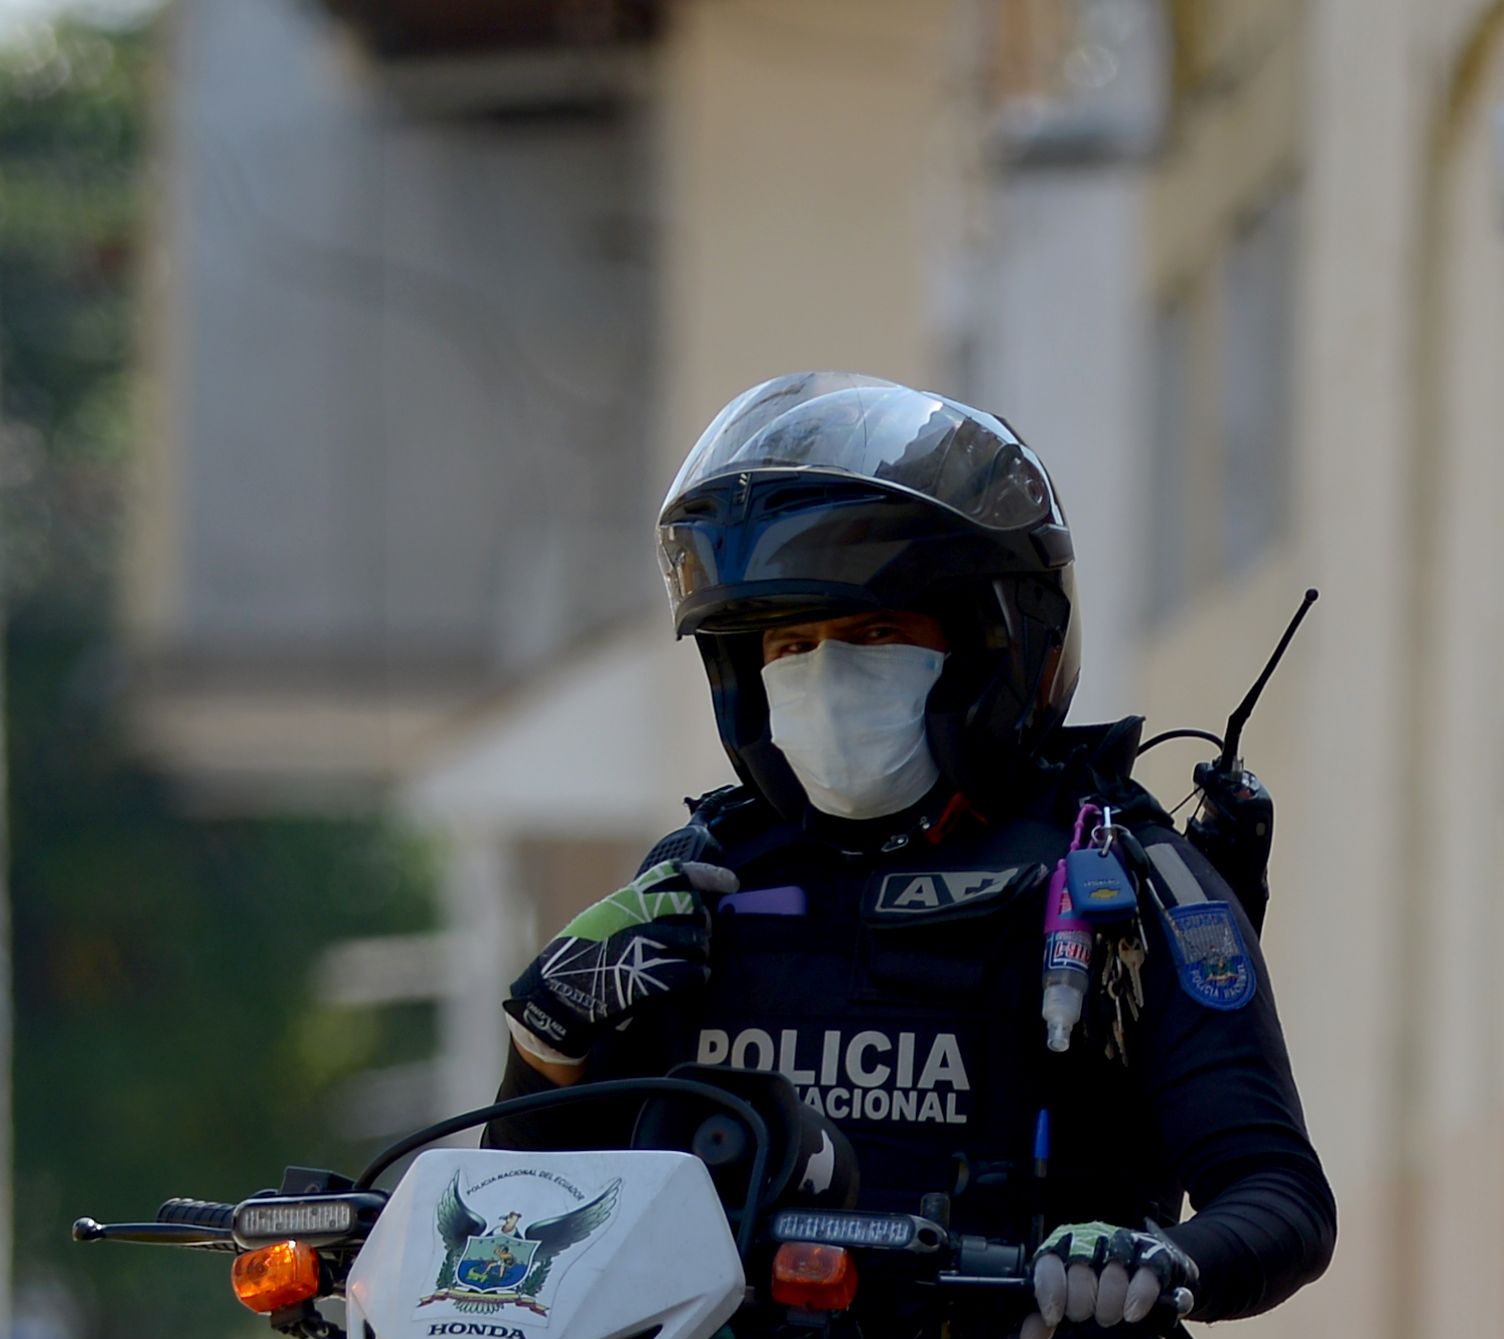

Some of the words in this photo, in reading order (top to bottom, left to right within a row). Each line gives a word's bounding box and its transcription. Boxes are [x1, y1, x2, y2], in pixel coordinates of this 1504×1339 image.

[696, 1028, 971, 1090] POLICIA
[796, 1087, 967, 1124] ACIONAL
[466, 1176, 496, 1196] POLICIA
[497, 1168, 537, 1181] NACIONAL
[538, 1170, 554, 1182] DEL
[553, 1175, 586, 1202] ECUADOR
